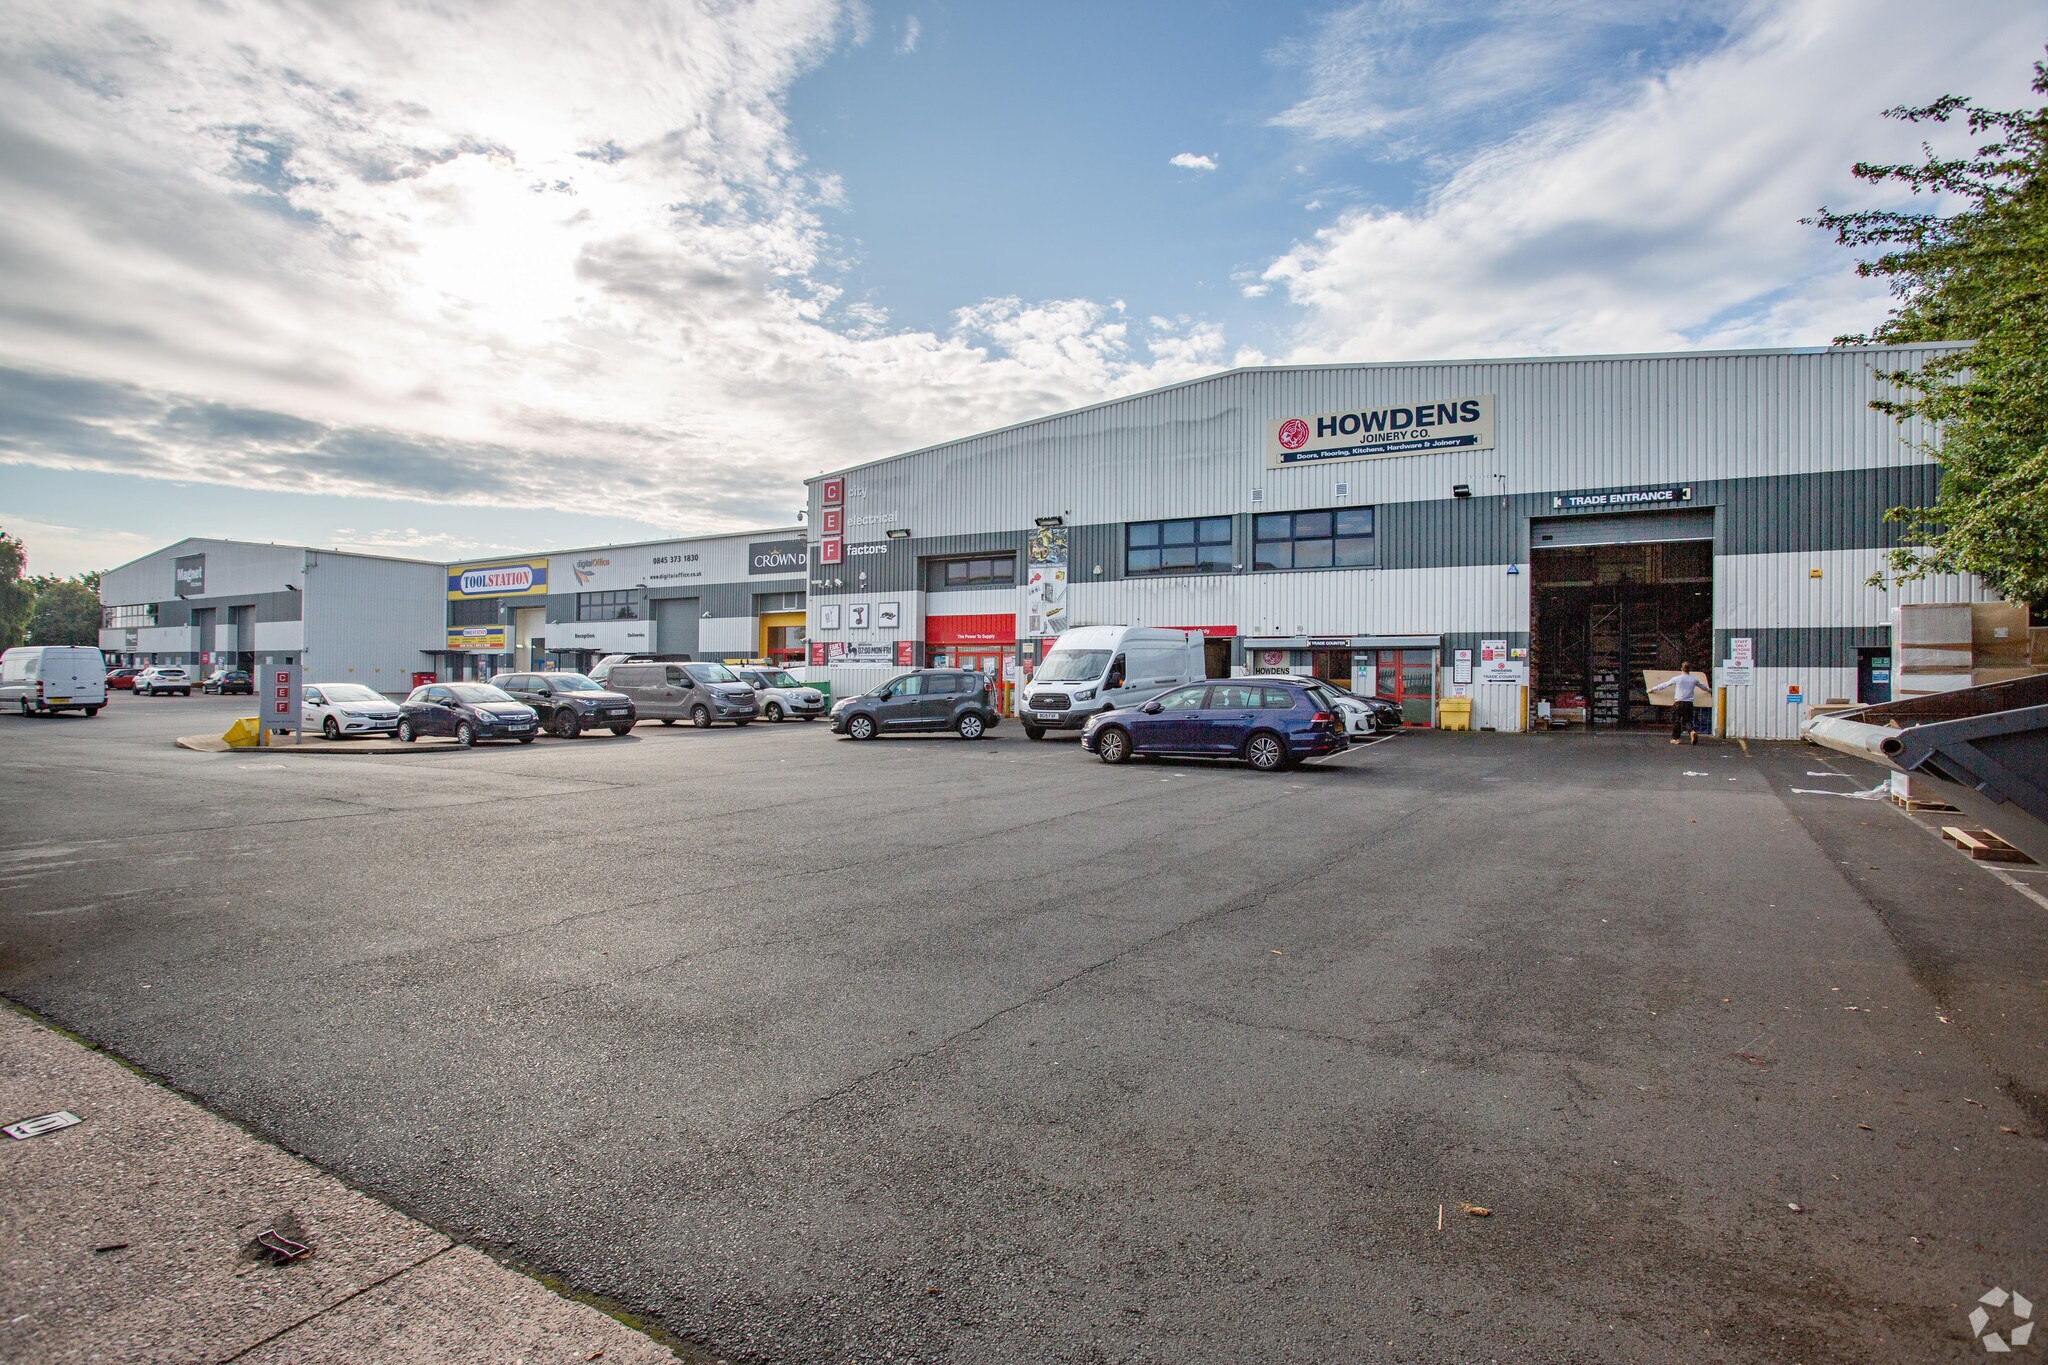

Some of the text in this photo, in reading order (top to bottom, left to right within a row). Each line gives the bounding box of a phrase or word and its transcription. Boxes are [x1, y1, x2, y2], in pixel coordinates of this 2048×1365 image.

[1317, 400, 1480, 437] HOWDENS
[1360, 428, 1431, 444] JOINERY CO.
[1297, 453, 1319, 461] Doors,
[1321, 449, 1350, 458] Flooring,
[1352, 446, 1385, 455] Kitchens,
[1387, 443, 1422, 451] Hardware
[1432, 438, 1461, 447] Joinery
[827, 485, 868, 498] C city
[1569, 491, 1673, 506] TRADE ENTRANCE
[827, 510, 898, 528] E electrical
[827, 544, 888, 557] F factors
[577, 557, 610, 569] digitalOffice
[653, 554, 699, 565] 0845 373 1830
[754, 553, 807, 567] CROWN D
[177, 566, 203, 582] Magnet
[464, 572, 530, 588] TOOLSTATION
[650, 571, 702, 581] www.digitaloffice.co.uk
[871, 646, 891, 654] MON-FRI
[1255, 667, 1290, 675] HOWDENS
